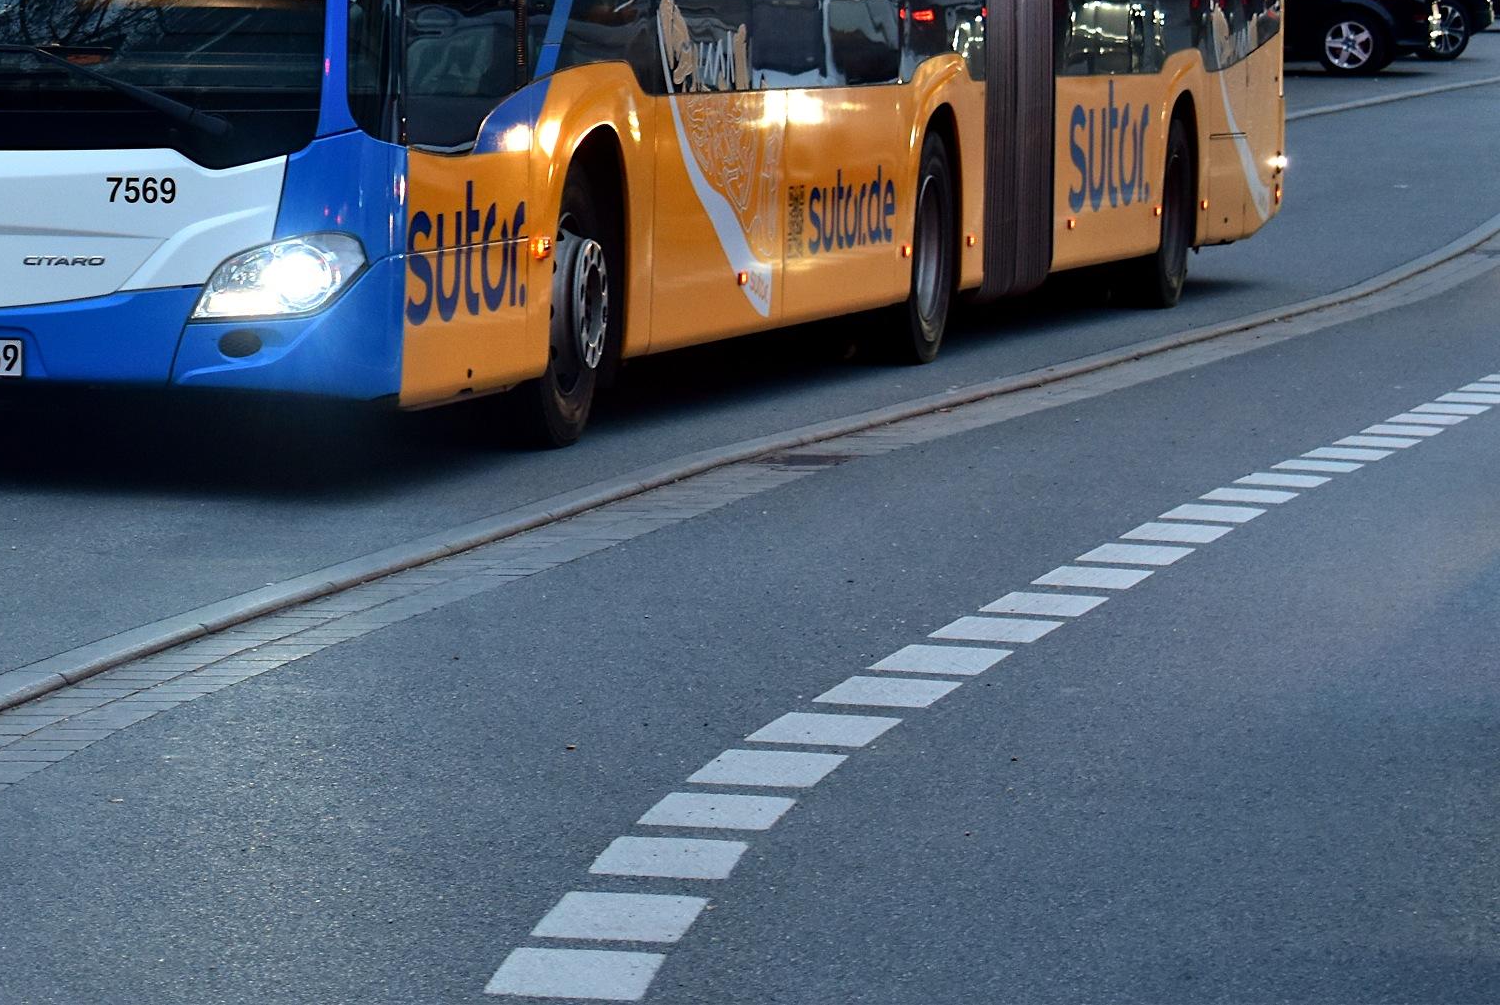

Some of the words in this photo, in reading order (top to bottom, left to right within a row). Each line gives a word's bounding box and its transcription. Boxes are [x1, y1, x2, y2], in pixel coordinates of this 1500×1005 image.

[106, 177, 176, 203] 7569
[1068, 79, 1150, 214] sutor.
[407, 180, 526, 326] sutor.
[808, 165, 895, 255] sutor.de
[23, 256, 106, 267] CITARO
